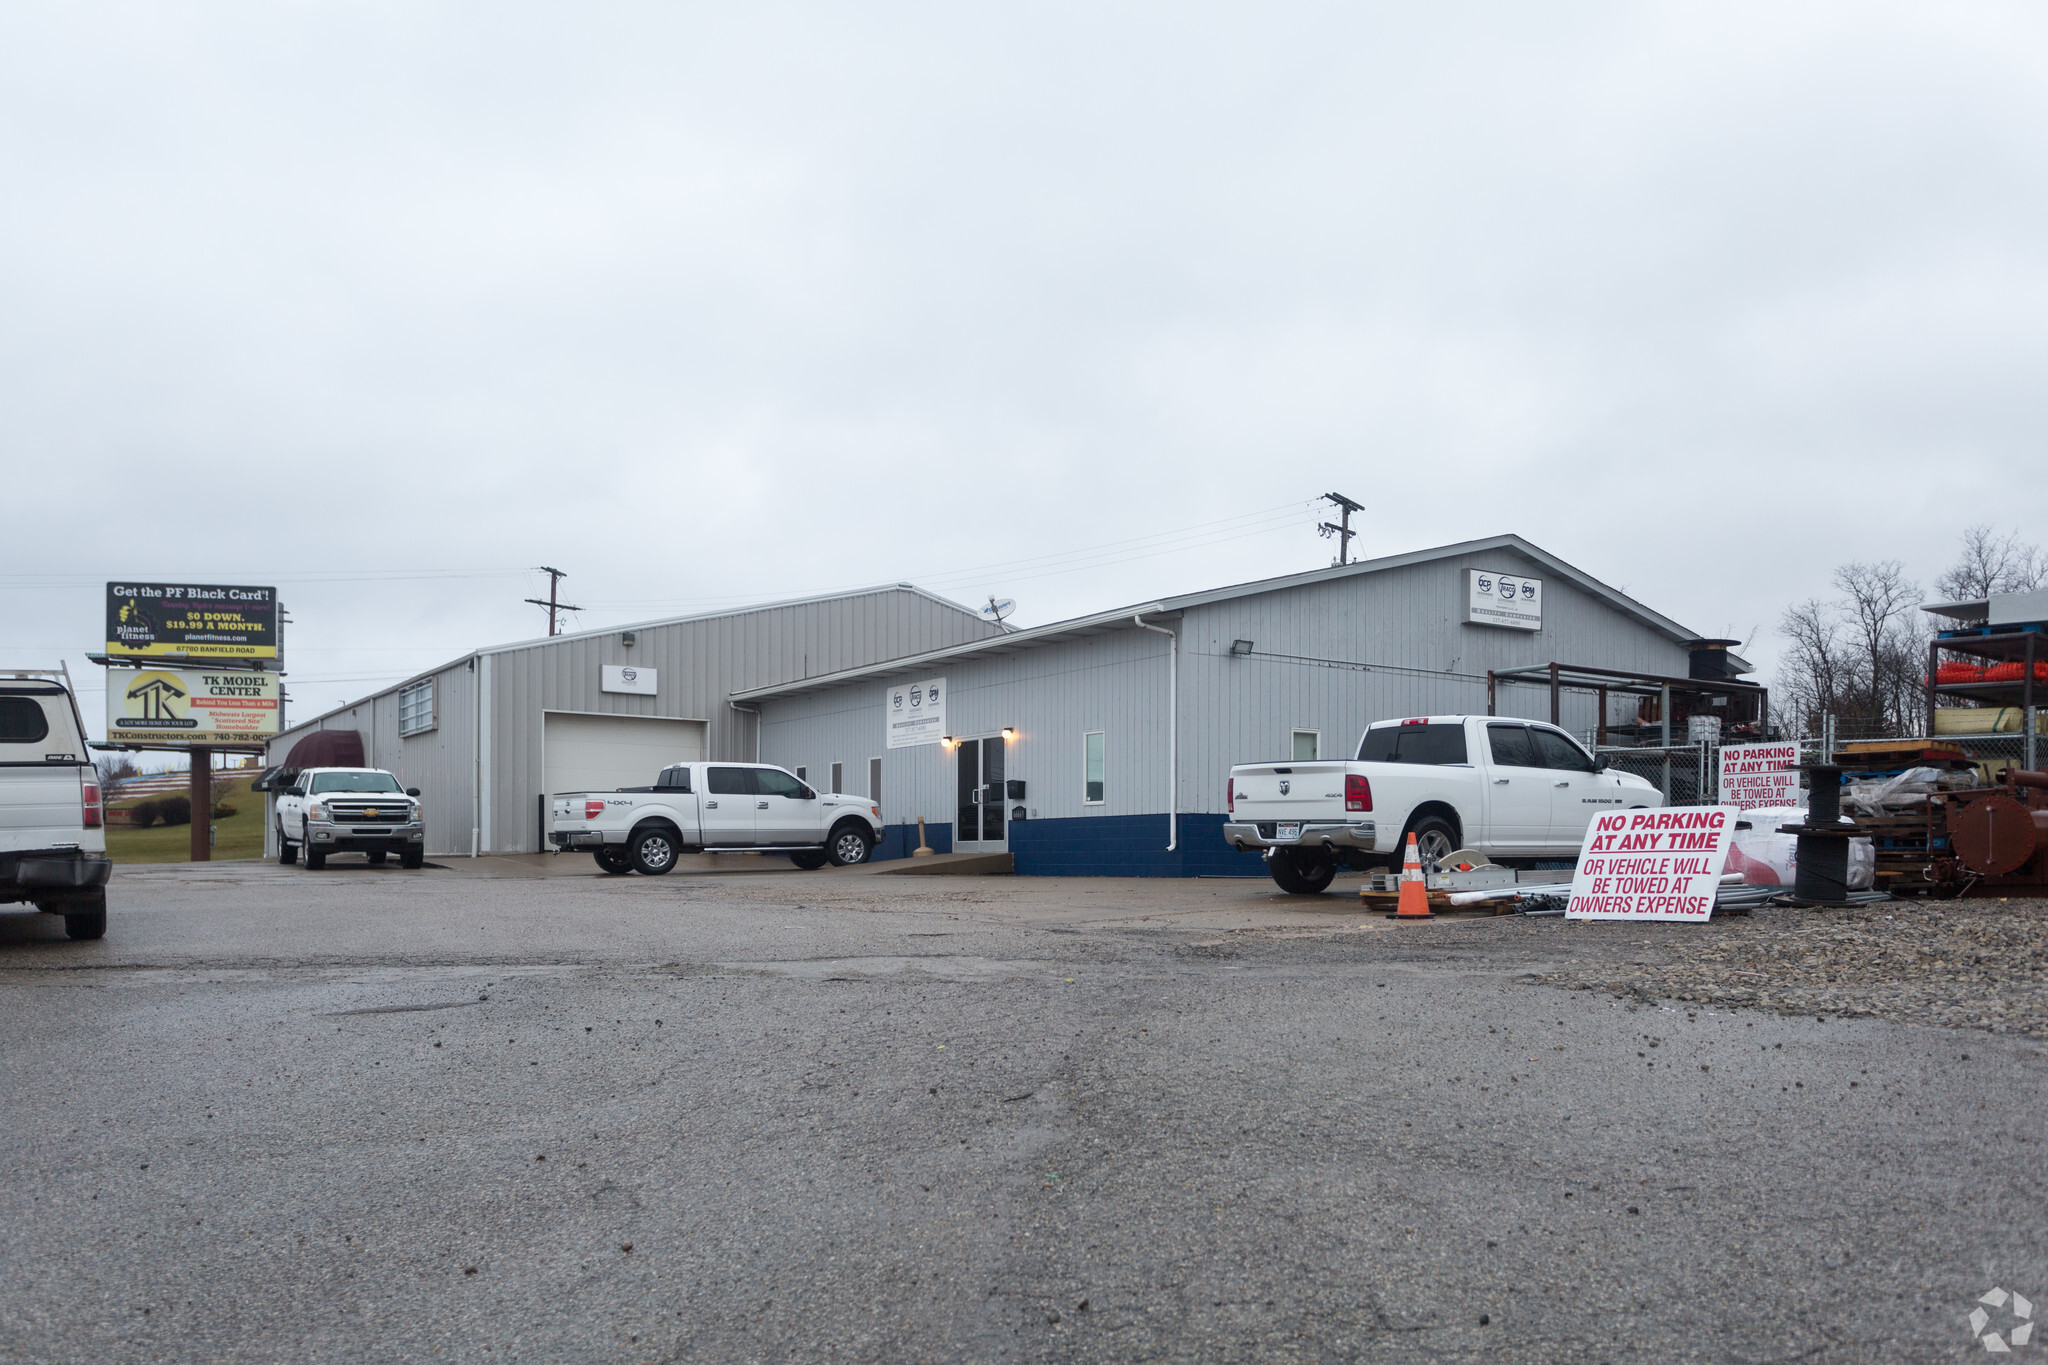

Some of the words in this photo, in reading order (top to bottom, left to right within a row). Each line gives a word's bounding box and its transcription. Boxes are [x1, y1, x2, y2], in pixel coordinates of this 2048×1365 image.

[113, 586, 138, 597] Get
[141, 586, 162, 598] the
[165, 587, 185, 598] PF
[187, 588, 226, 600] Black
[186, 611, 200, 621] $0
[203, 612, 245, 622] DOWN.
[116, 625, 149, 634] planet
[166, 620, 203, 630] $19.99
[206, 621, 215, 630] A
[217, 621, 266, 631] MONTH.
[121, 632, 155, 641] fitness
[184, 633, 247, 642] planetfitness.com
[200, 646, 235, 654] BANFIELD
[202, 675, 220, 686] TK
[222, 676, 268, 687] MODEL
[209, 686, 262, 697] CENTER
[208, 710, 239, 718] Midwests
[241, 712, 266, 720] Largest
[111, 731, 207, 741] TKConstructors.com
[213, 732, 272, 741] 740-782-00
[1723, 749, 1740, 761] NO
[1743, 746, 1795, 760] PARKING
[1723, 762, 1738, 773] AT
[1739, 761, 1763, 772] ANY
[1723, 778, 1735, 789] OR
[1736, 776, 1771, 788] VEHICLE
[1773, 775, 1794, 787] WILL
[1731, 789, 1741, 800] BE
[1743, 788, 1773, 799] TOWED
[1775, 787, 1786, 798] AT
[1596, 815, 1627, 832] NO
[1630, 811, 1725, 831] PARKING
[1590, 834, 1618, 851] AT
[1618, 833, 1664, 850] ANY
[1668, 832, 1720, 849] TIME
[1583, 858, 1605, 875] OR
[1608, 858, 1670, 875] VEHICLE
[1673, 857, 1711, 875] WILL
[1591, 877, 1612, 894] BE
[1615, 877, 1669, 894] TOWED
[1671, 876, 1693, 894] AT
[1569, 896, 1633, 913] OWNERS
[1635, 896, 1709, 914] EXPENSE
